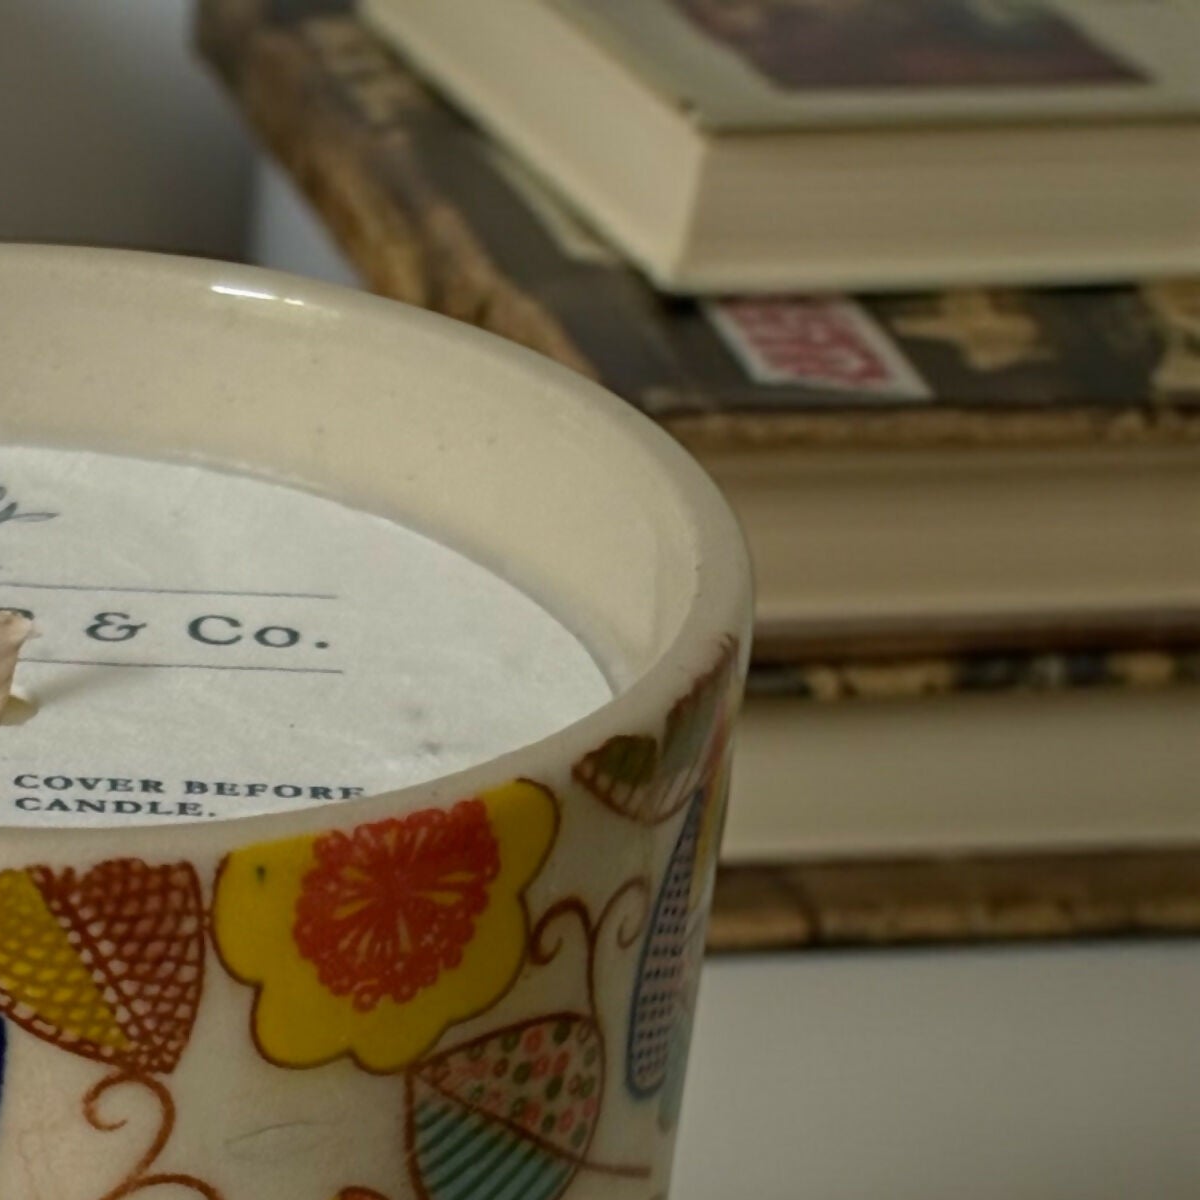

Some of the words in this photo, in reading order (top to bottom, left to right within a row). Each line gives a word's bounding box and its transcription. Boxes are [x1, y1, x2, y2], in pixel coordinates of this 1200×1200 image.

[85, 611, 147, 642] &
[187, 614, 329, 649] Co.
[13, 773, 165, 794] COVER
[184, 780, 364, 800] BEFORE
[15, 797, 217, 818] CANDLE.
